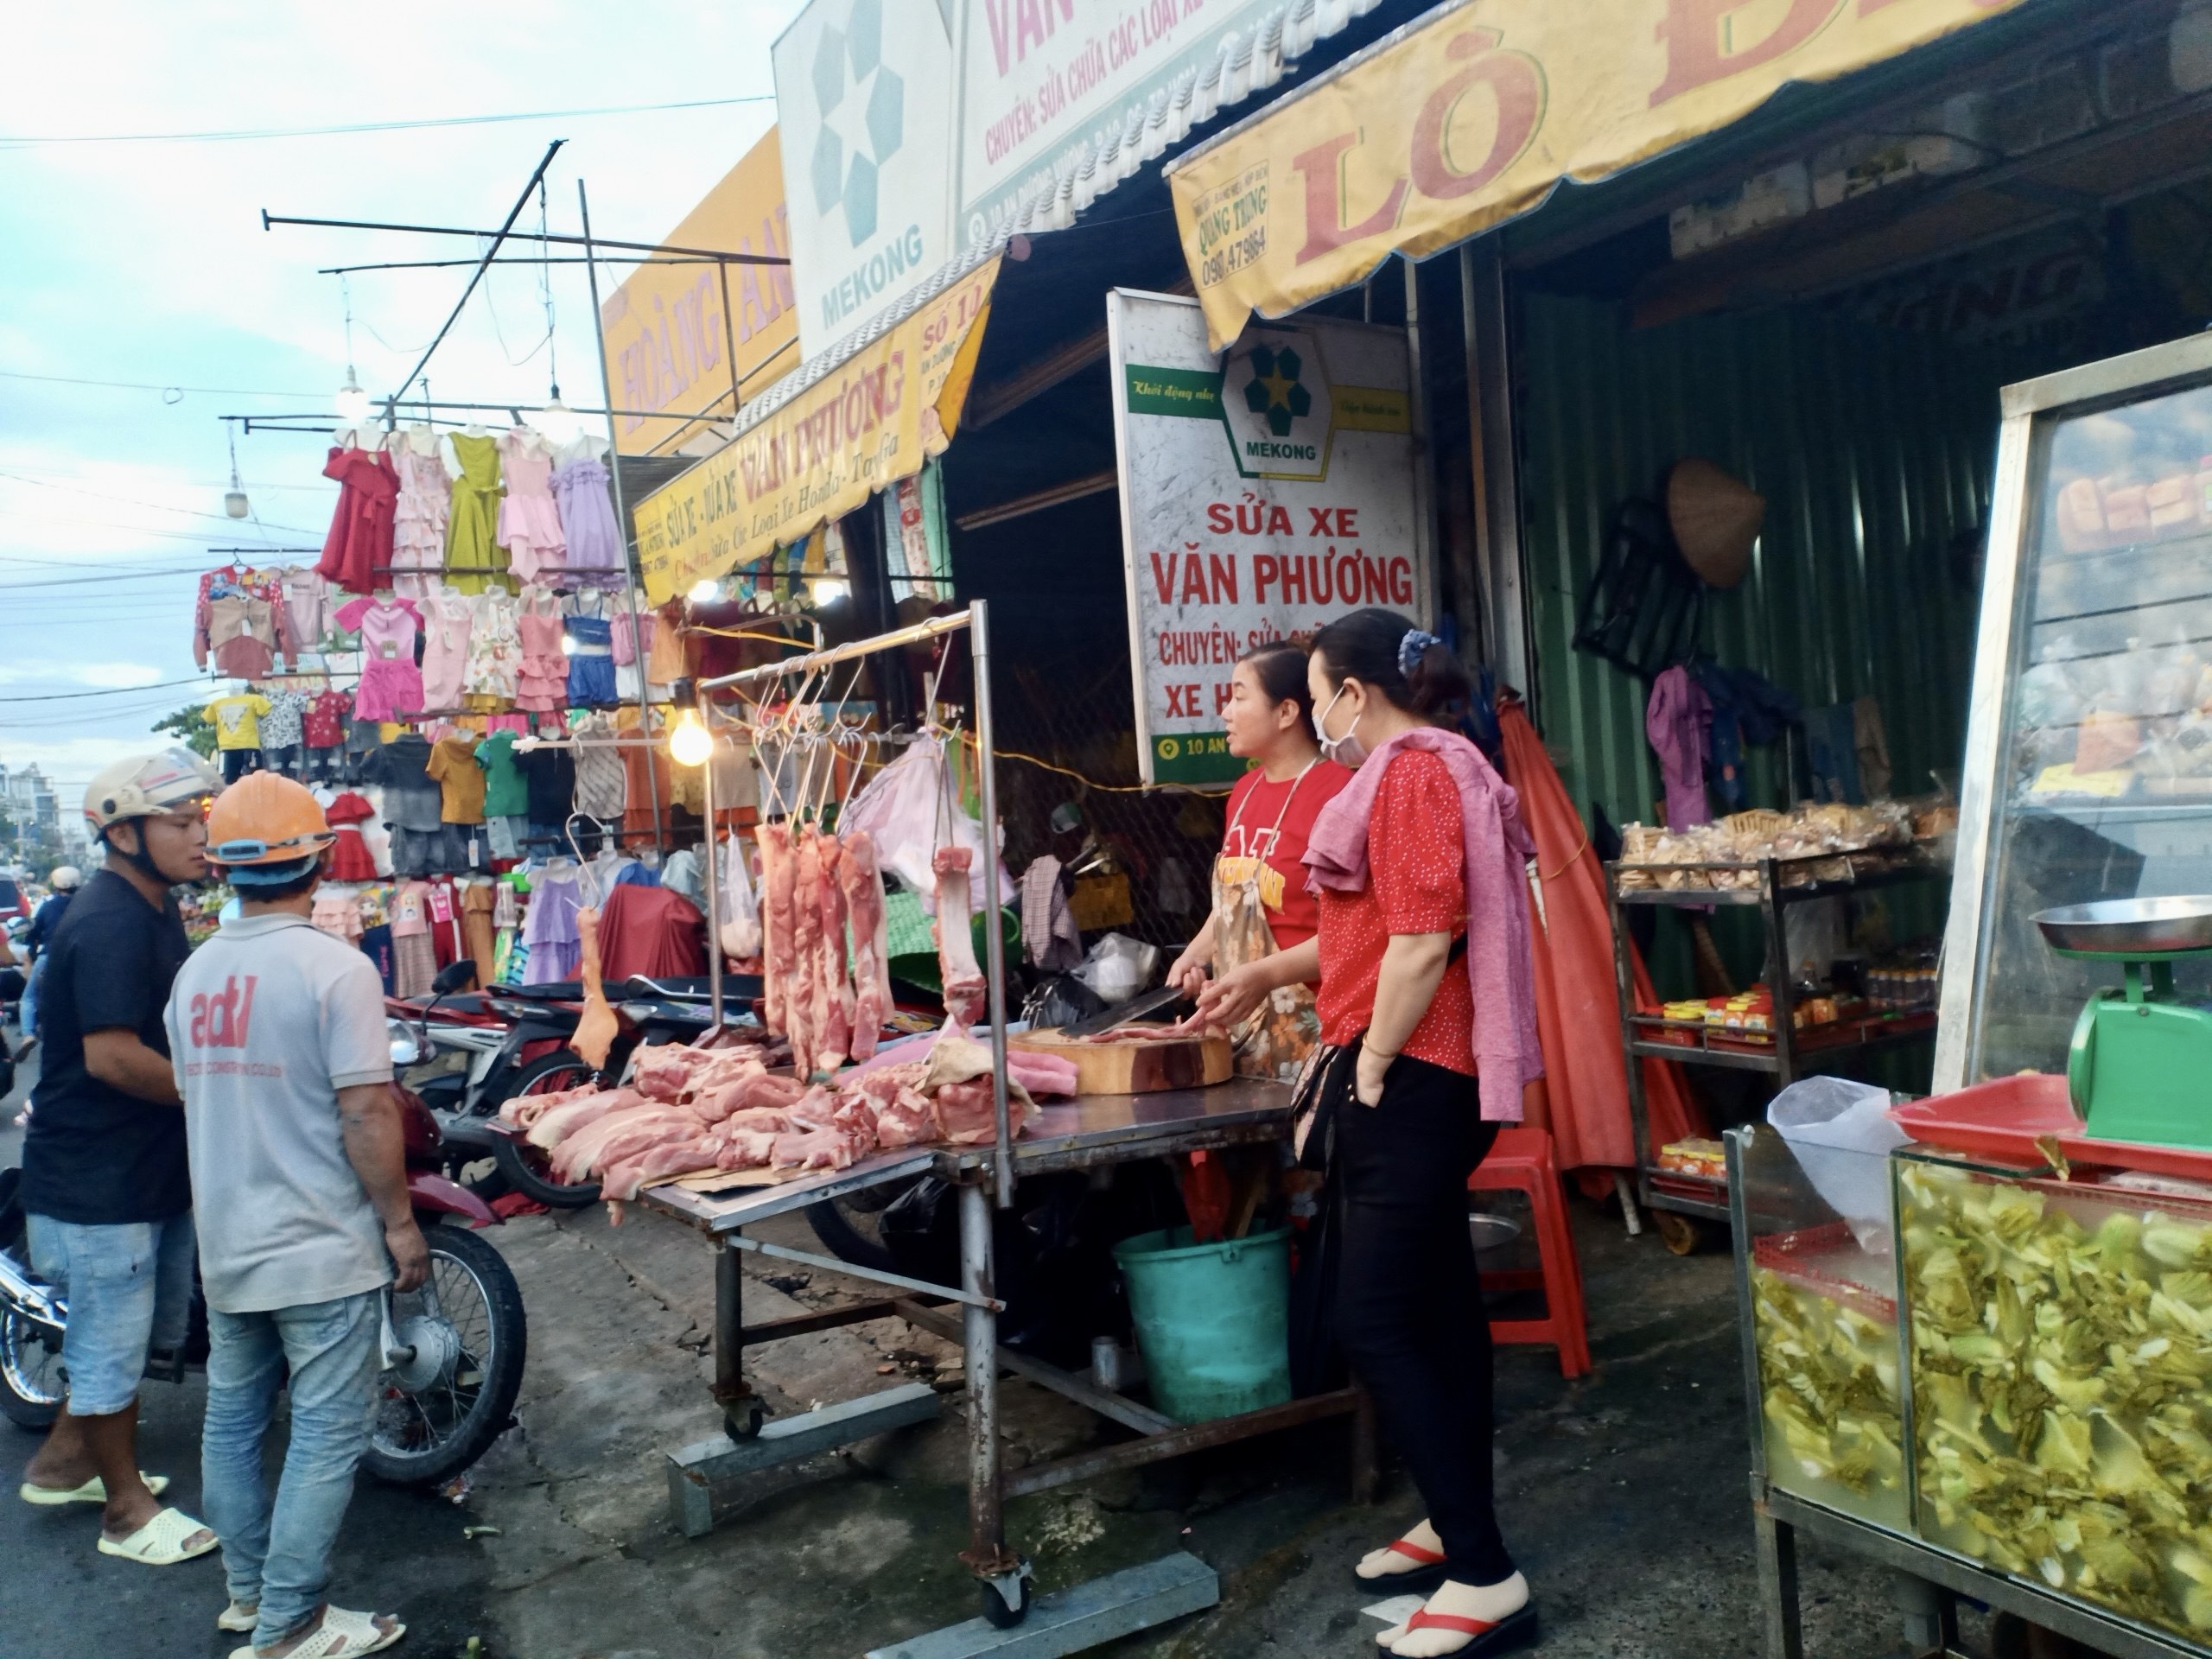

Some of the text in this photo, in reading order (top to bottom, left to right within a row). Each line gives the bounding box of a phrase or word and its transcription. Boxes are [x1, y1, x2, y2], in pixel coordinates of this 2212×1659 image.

[1039, 63, 1065, 125] SỬA
[1109, 14, 1138, 71] CÁC
[1198, 206, 1230, 257] QUANG
[1232, 184, 1267, 232] TRUNG
[822, 223, 923, 330] MEKONG
[619, 270, 720, 435] HOÀNG
[924, 309, 948, 353] SỐ
[794, 351, 905, 476] PHƯƠNG
[1247, 442, 1316, 461] MEKONG
[1207, 492, 1359, 537] SỬA XE
[1150, 542, 1413, 605] VĂN PHƯƠNG
[1159, 622, 1242, 665] CHUYÊN:
[1164, 683, 1203, 718] XE
[1187, 740, 1204, 754] 10
